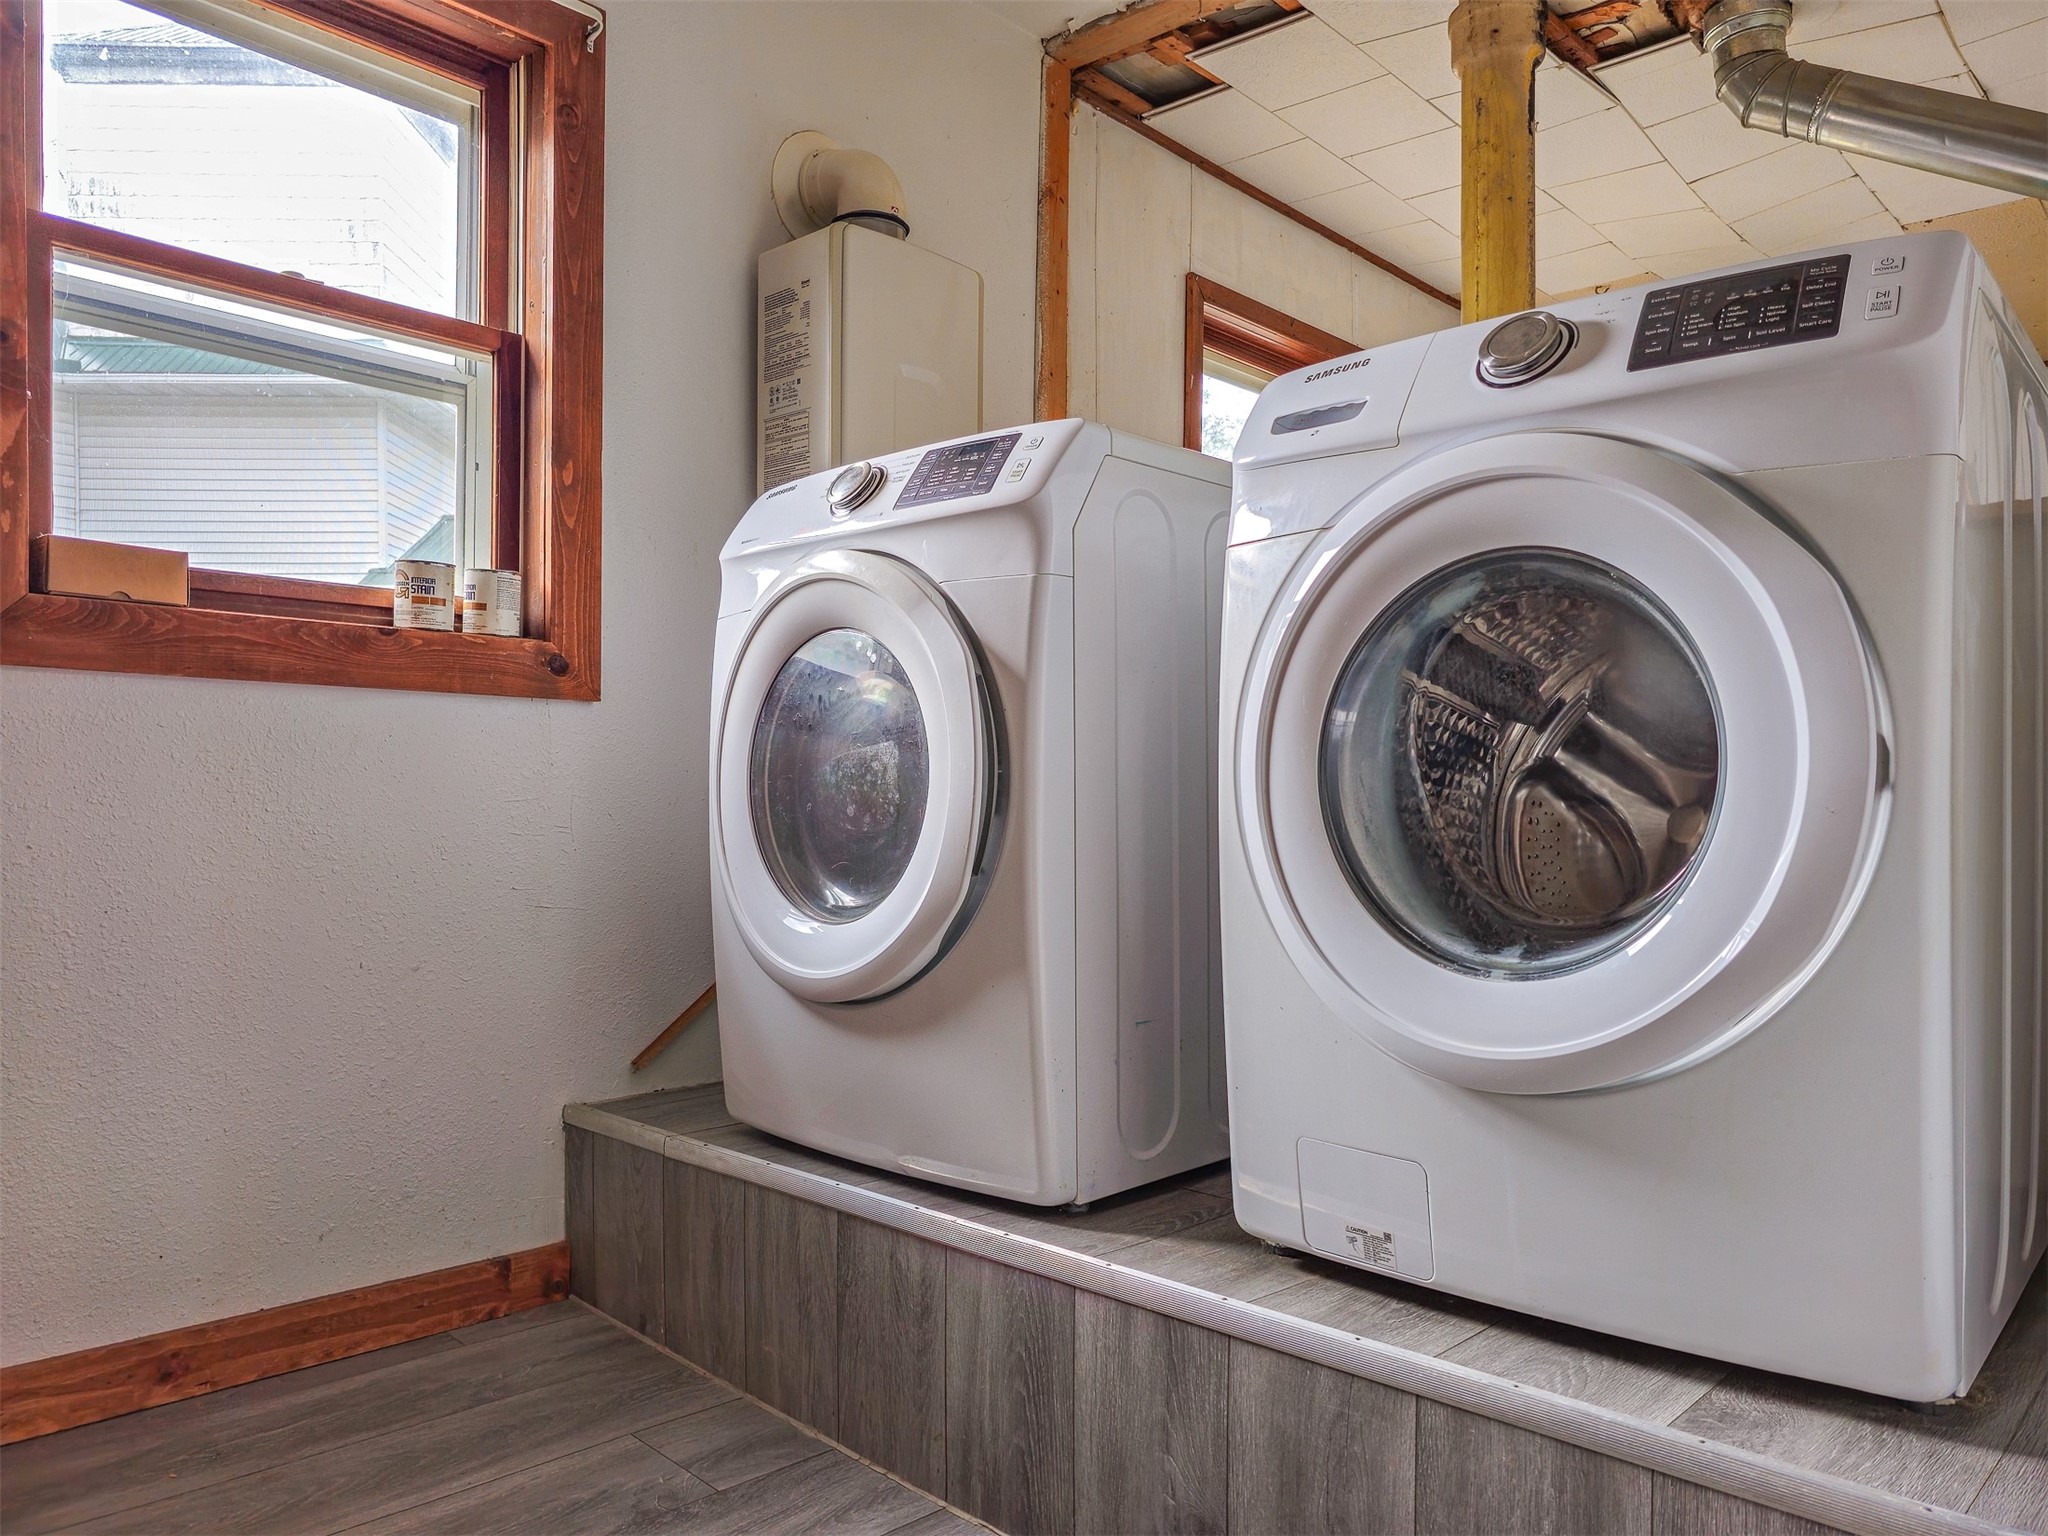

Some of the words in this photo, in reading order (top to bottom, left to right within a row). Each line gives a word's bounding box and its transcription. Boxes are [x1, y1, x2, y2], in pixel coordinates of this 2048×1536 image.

[1304, 358, 1371, 383] SAMSUNG
[410, 576, 436, 586] INTERIOR
[410, 584, 436, 595] STAIN
